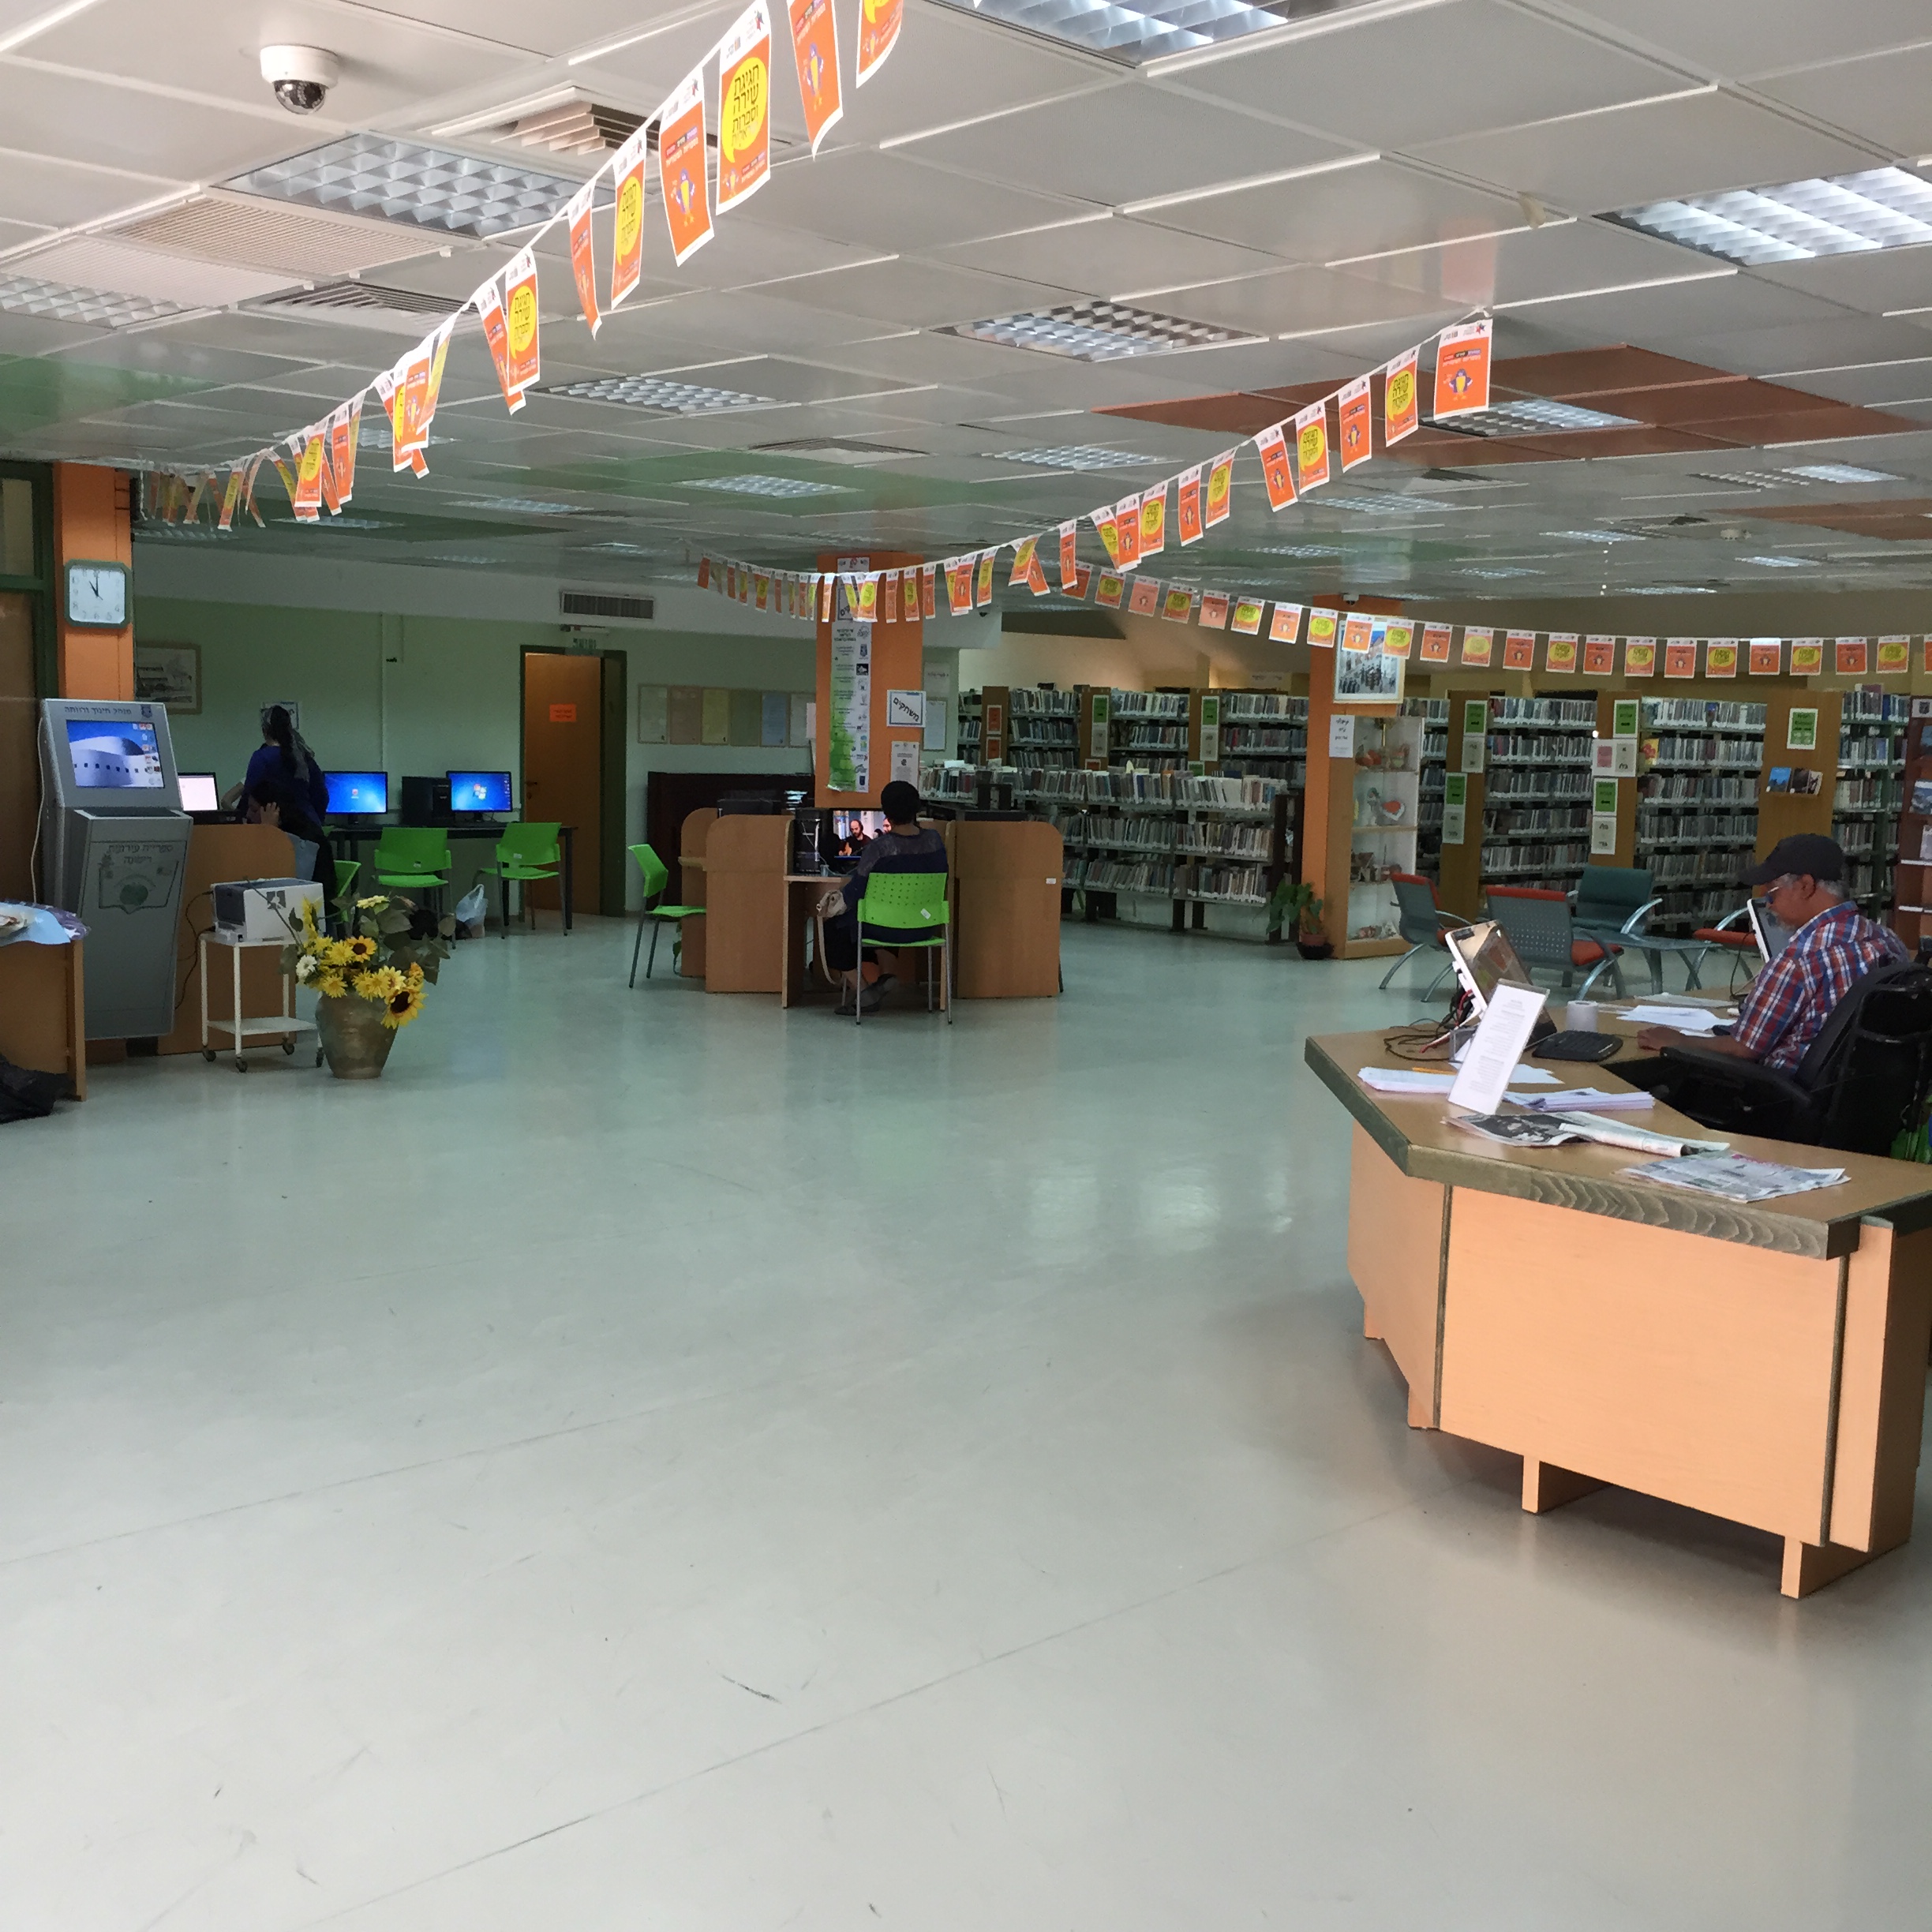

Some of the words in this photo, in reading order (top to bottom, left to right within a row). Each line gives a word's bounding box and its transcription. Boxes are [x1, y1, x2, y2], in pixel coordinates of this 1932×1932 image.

[733, 64, 759, 96] חגיגת
[733, 83, 759, 115] שירה
[732, 104, 758, 133] וספרות
[893, 697, 919, 722] משחקים
